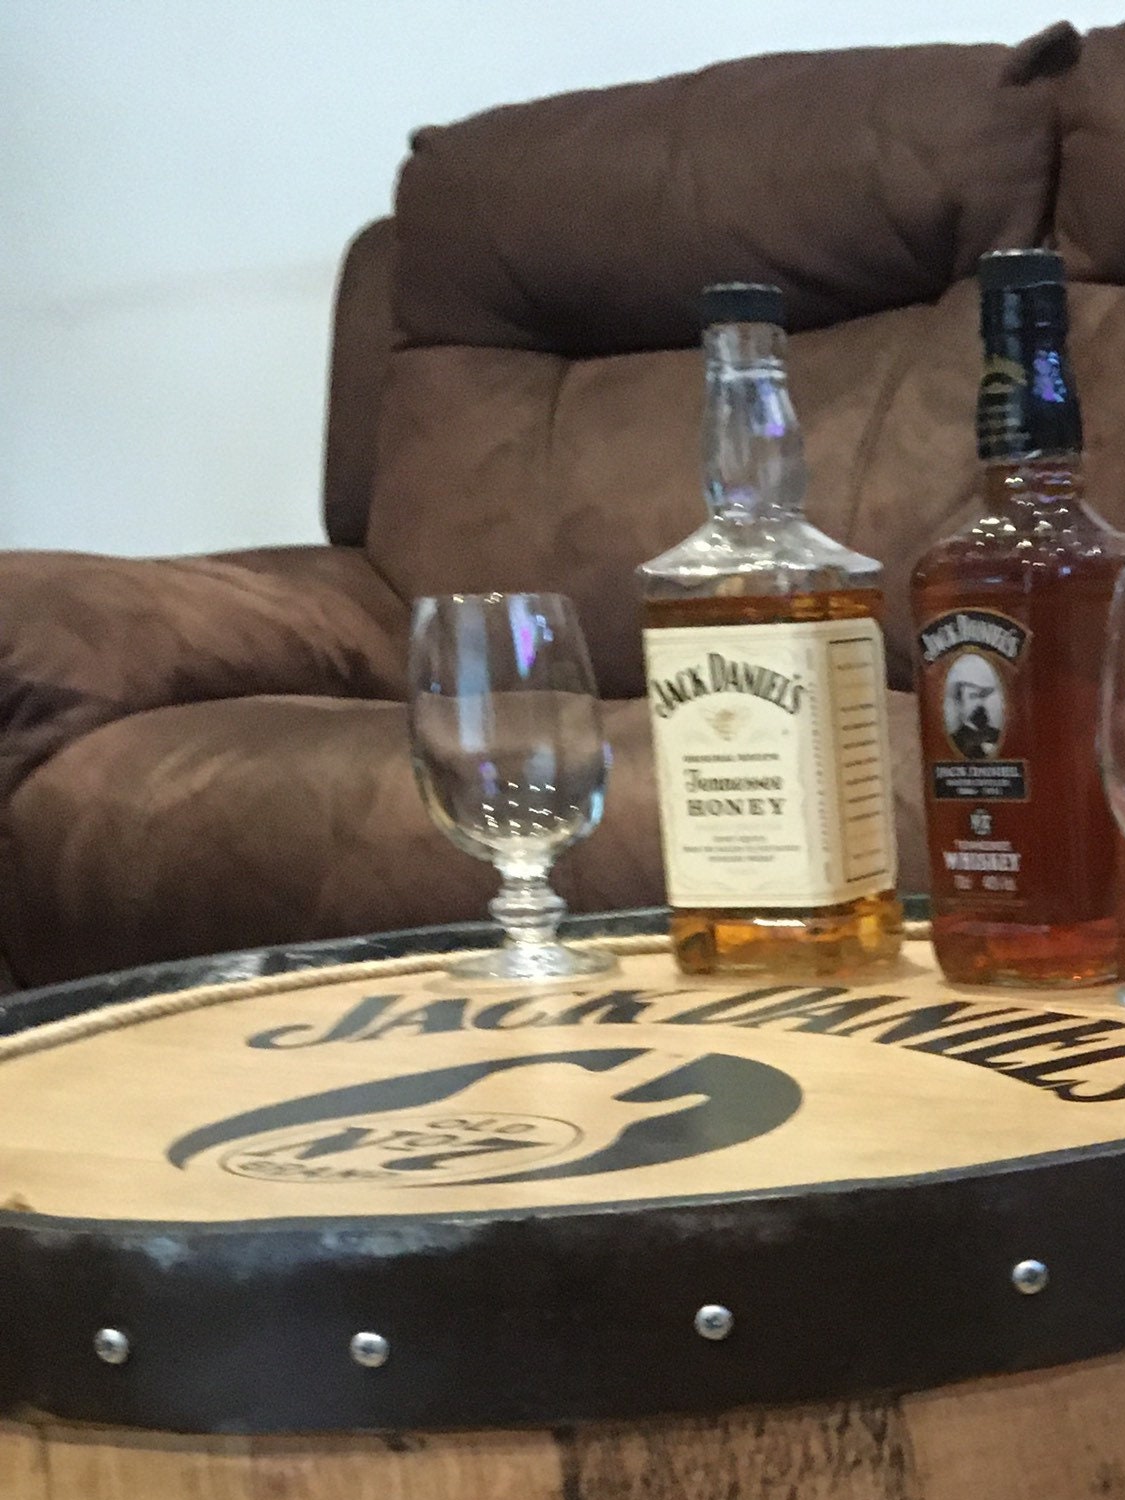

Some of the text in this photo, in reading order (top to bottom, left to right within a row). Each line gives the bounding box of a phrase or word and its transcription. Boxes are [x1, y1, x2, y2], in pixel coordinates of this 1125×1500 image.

[650, 664, 710, 719] JACK
[687, 798, 787, 817] HONEY
[246, 989, 704, 1049] JACK
